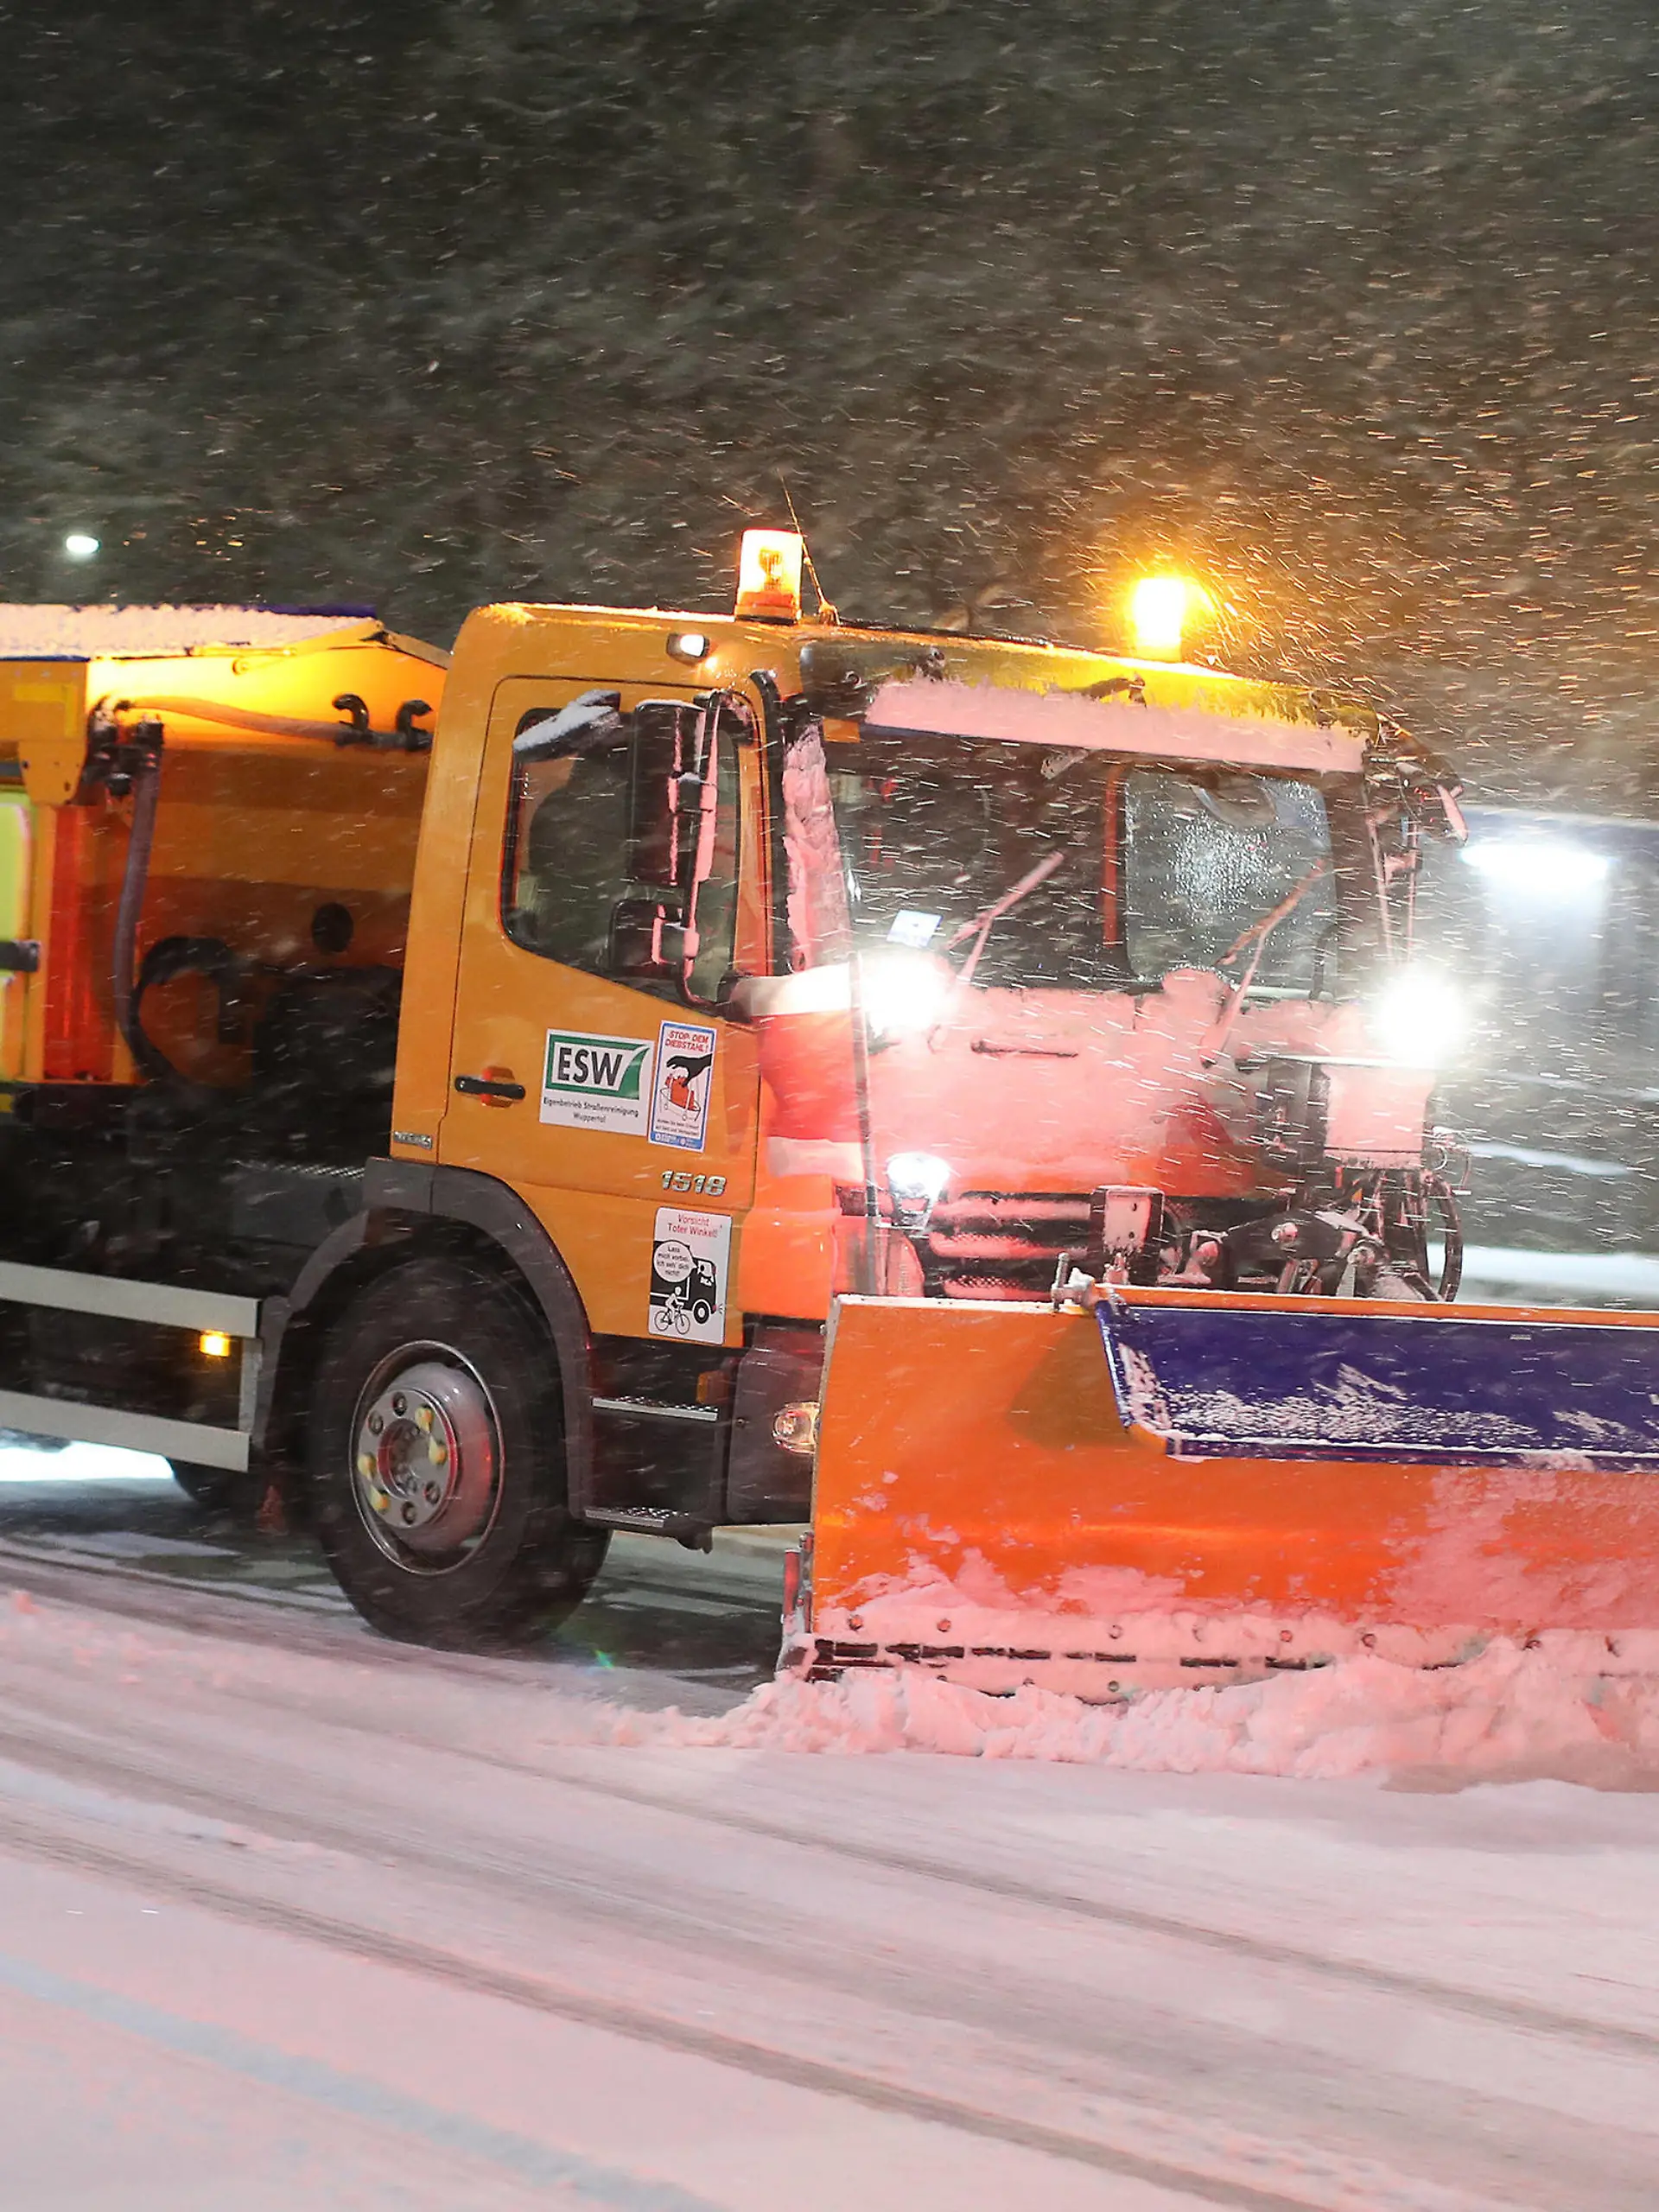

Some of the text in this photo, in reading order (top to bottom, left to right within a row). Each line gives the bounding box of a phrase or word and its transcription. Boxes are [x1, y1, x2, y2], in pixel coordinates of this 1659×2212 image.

[691, 1033, 709, 1044] DEM
[557, 1046, 623, 1087] ESW
[543, 1096, 639, 1117] Eigenbetrieb Straßenreinigung
[573, 1112, 607, 1122] Wuppertal
[660, 1169, 728, 1197] 1518
[677, 1214, 710, 1226] Vorsicht
[667, 1223, 688, 1234] Toter
